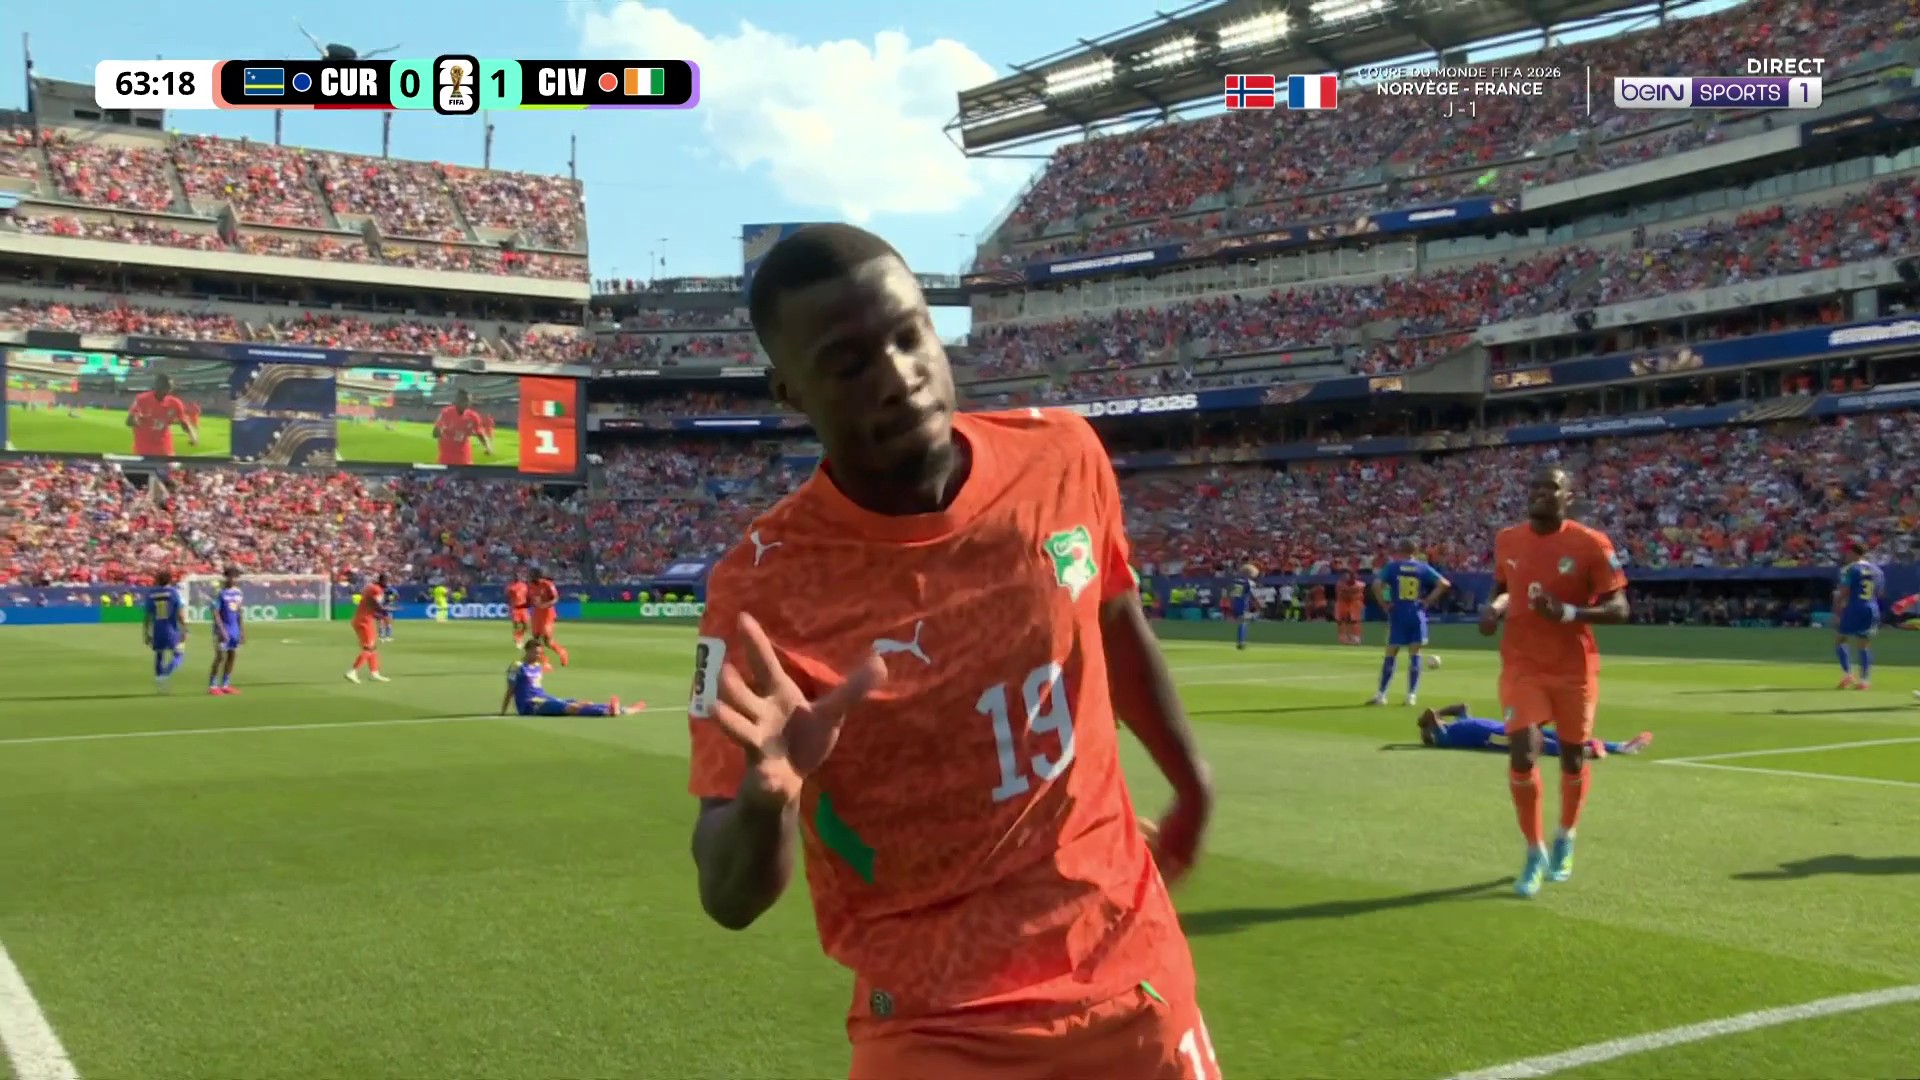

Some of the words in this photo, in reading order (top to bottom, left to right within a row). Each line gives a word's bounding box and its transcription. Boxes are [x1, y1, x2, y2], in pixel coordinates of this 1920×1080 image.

[1106, 400, 1138, 415] CUP
[1139, 394, 1198, 413] 2026
[535, 429, 560, 455] 1
[640, 602, 706, 617] aramc
[975, 660, 1075, 803] 19
